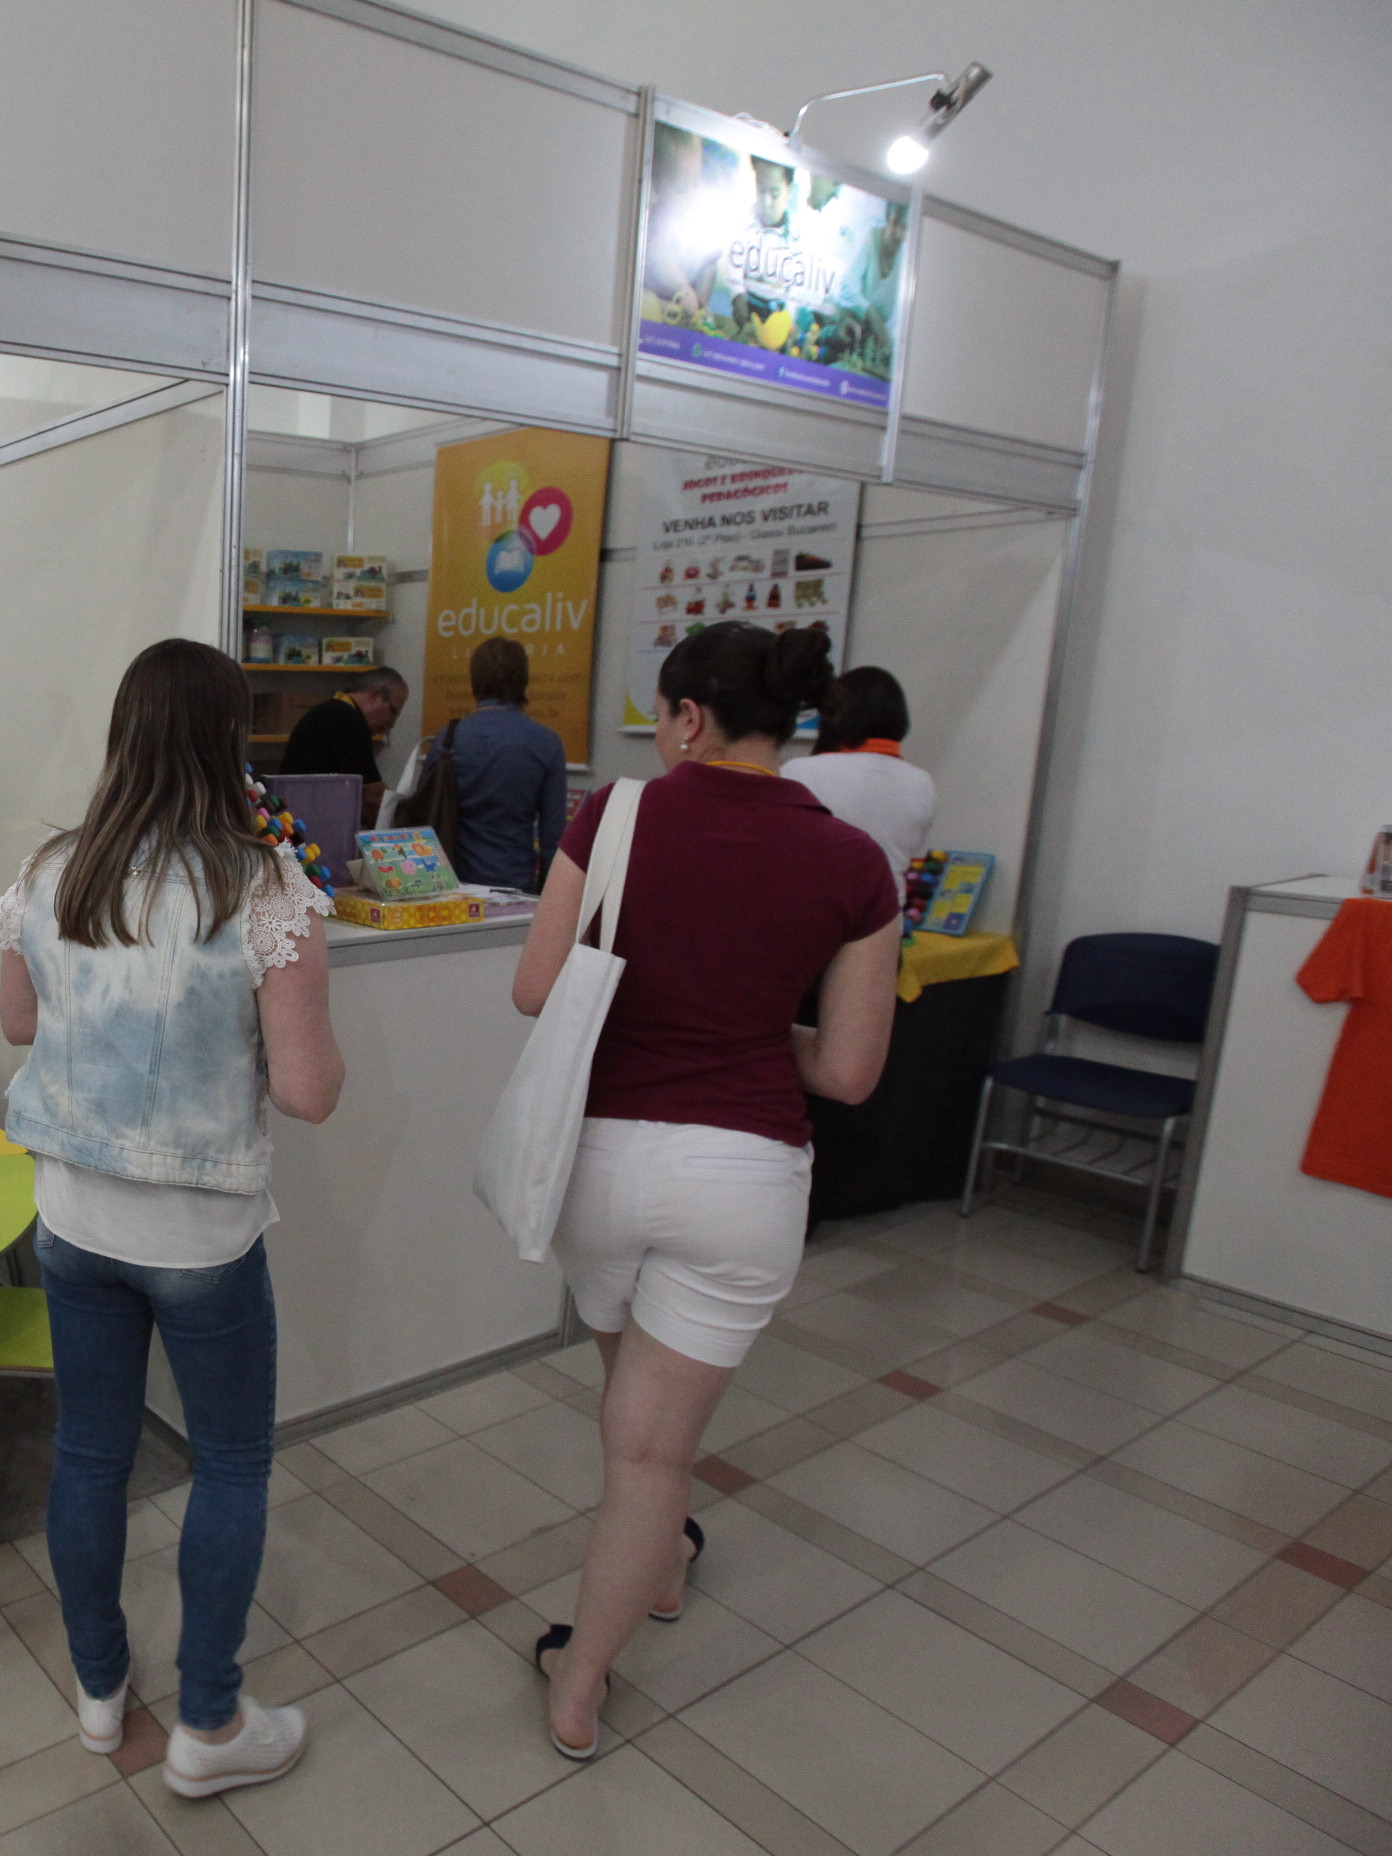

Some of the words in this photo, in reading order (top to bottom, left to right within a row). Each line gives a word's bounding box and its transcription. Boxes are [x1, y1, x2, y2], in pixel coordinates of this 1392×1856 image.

[729, 234, 836, 295] educaliv
[662, 515, 717, 534] VENHA
[720, 510, 756, 527] NOS
[761, 501, 830, 523] VISITAR
[437, 592, 588, 637] educaliv
[451, 642, 566, 659] LIRIA
